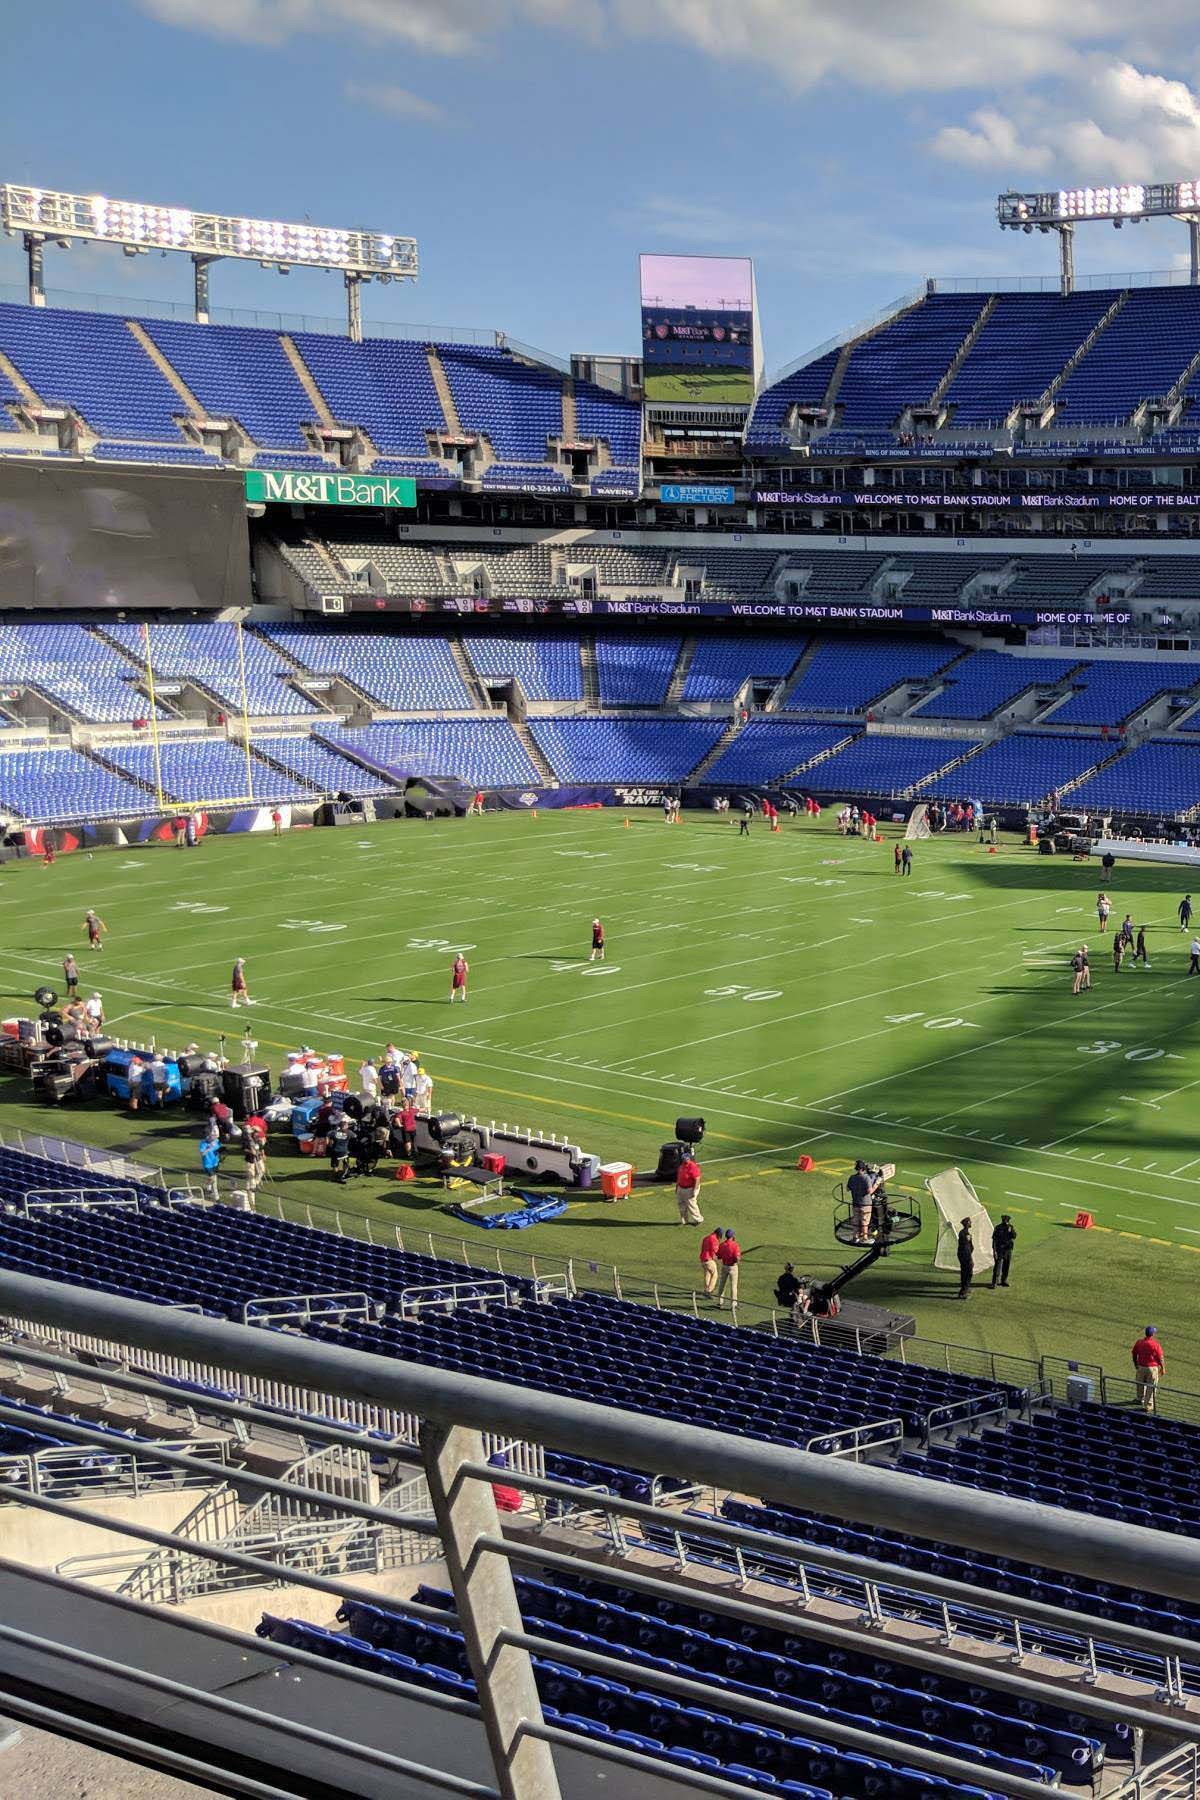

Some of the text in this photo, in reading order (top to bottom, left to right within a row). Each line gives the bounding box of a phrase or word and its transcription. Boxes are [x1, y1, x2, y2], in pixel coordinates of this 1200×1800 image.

[263, 472, 401, 505] M&T Bank
[597, 488, 634, 496] RAVENS
[679, 493, 728, 501] FACTORY
[757, 492, 841, 504] M&T Bank Stadium
[854, 494, 1011, 505] WELCOME TO M&T BANK STADIUM
[1021, 495, 1099, 506] M&T Bank Stadium
[1109, 495, 1137, 505] HOME
[1139, 495, 1154, 505] OF
[1155, 495, 1174, 505] THE
[607, 602, 700, 614] M&T Bank Stadium
[732, 605, 903, 618] WELCOME TO M&T BANK STADIUM
[931, 609, 1012, 622] M&T Bank Stadium
[1036, 613, 1065, 623] HOME
[1067, 614, 1081, 623] OF
[615, 788, 646, 796] PLAY
[703, 984, 784, 1001] 50
[882, 1011, 965, 1029] 40
[1076, 1040, 1167, 1062] 30
[616, 1174, 629, 1188] G
[1076, 1212, 1090, 1228] 20
